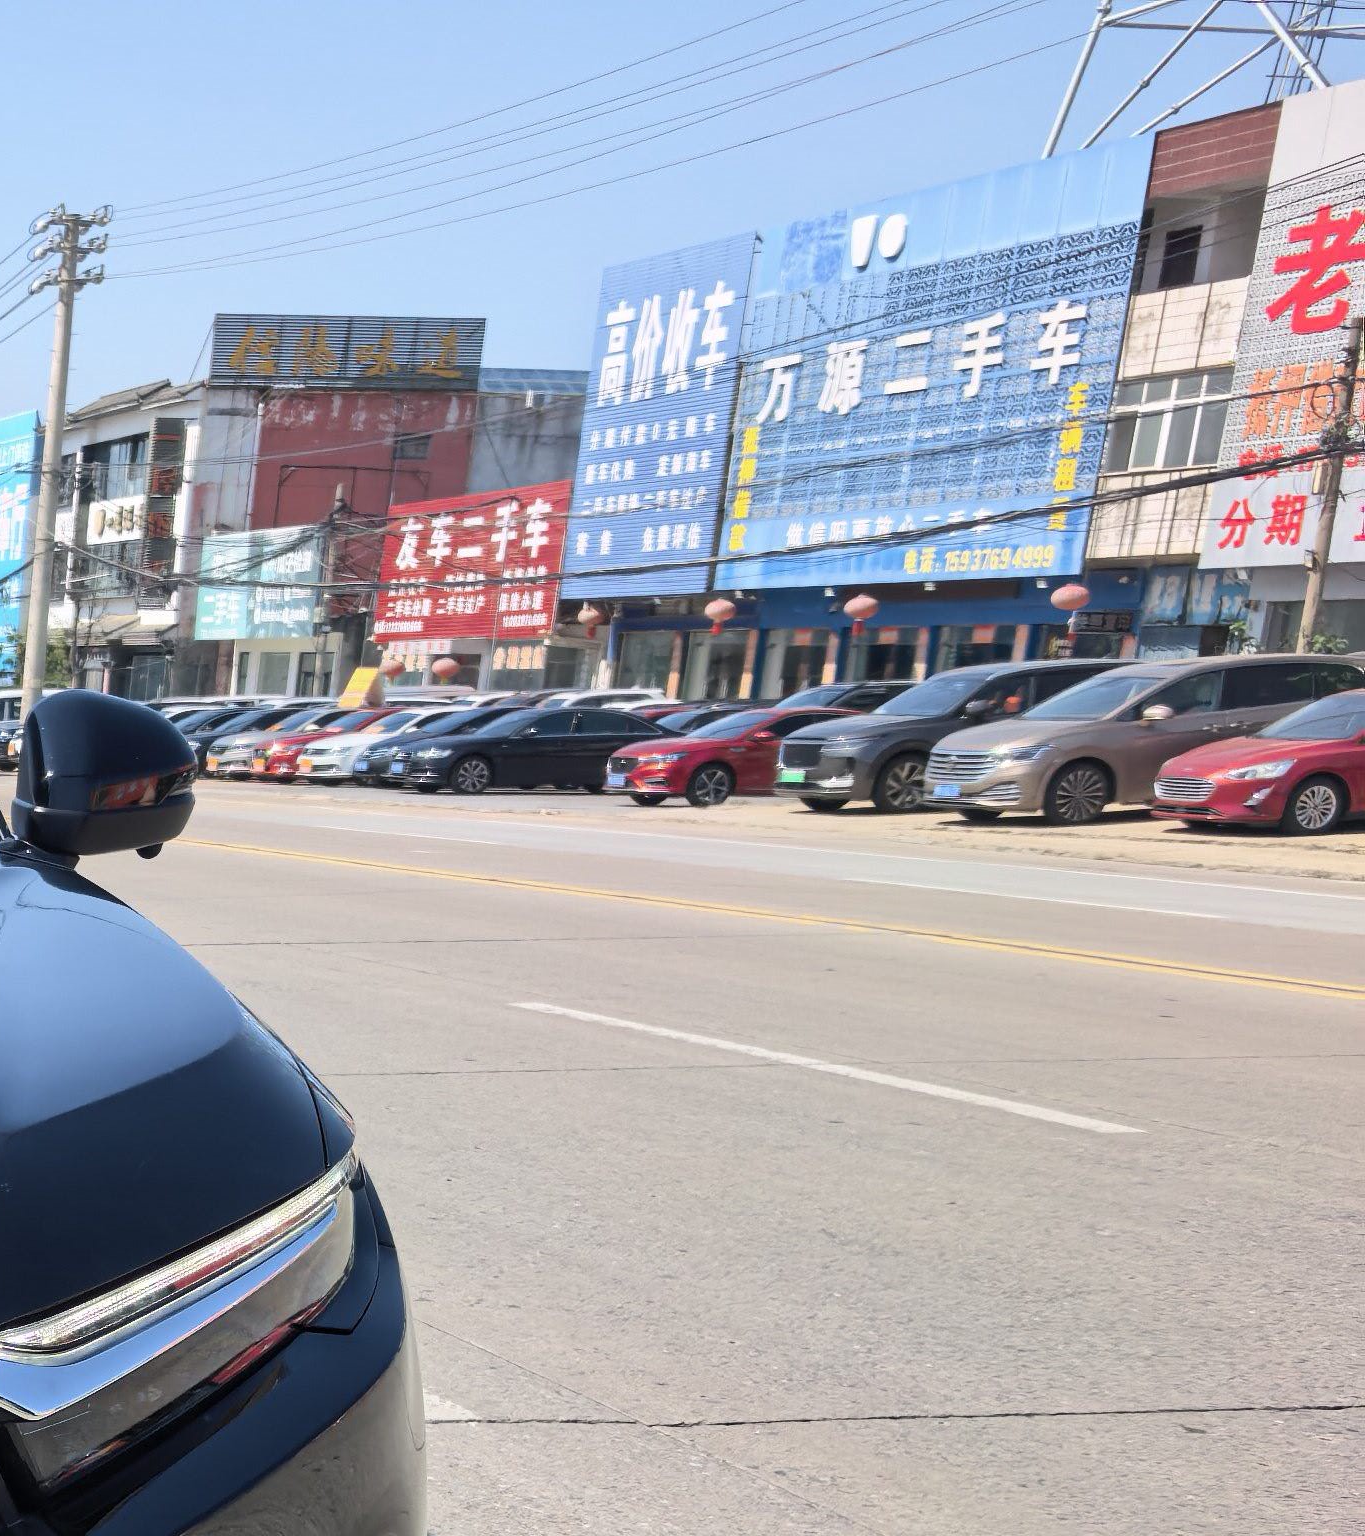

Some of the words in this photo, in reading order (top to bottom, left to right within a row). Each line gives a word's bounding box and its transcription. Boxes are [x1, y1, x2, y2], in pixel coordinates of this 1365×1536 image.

[1265, 204, 1365, 334] 老
[598, 280, 735, 406] 高价收车
[756, 299, 1088, 422] 万源二手车
[1218, 495, 1309, 549] 分期
